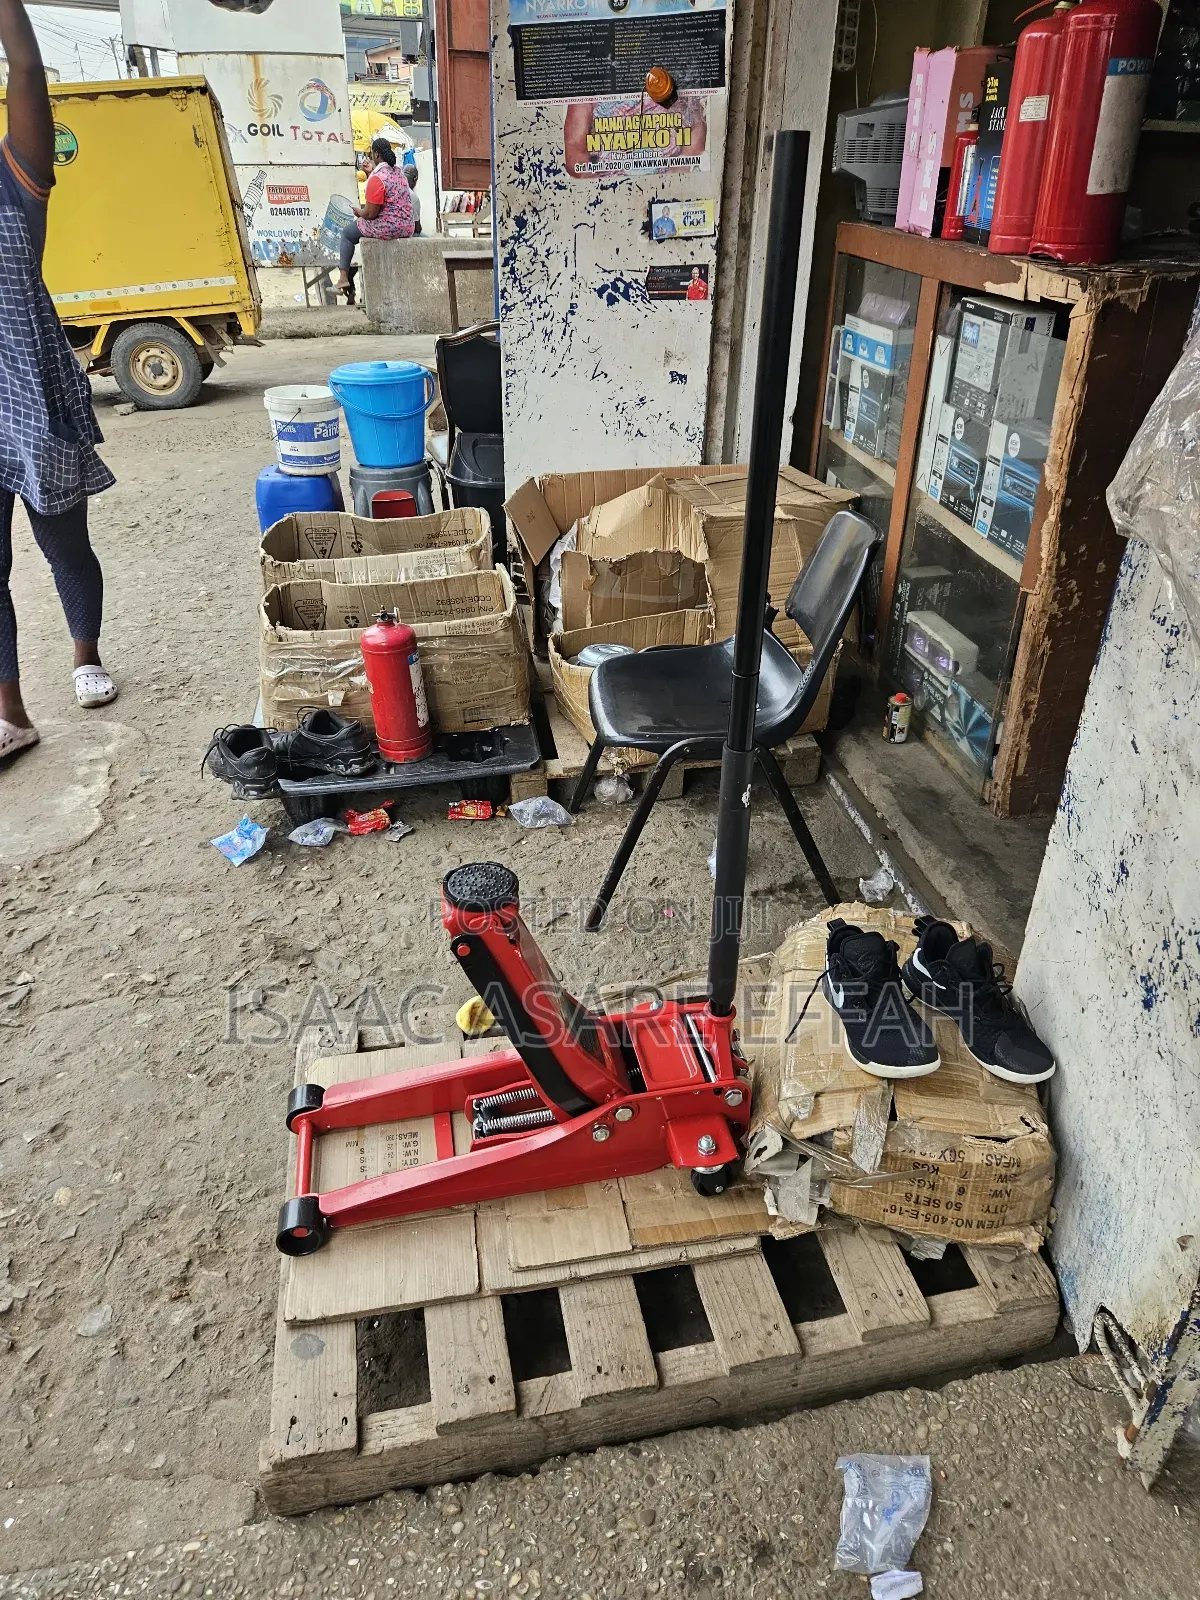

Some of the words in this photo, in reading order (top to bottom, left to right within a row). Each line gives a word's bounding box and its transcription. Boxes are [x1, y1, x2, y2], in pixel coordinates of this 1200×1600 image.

[595, 117, 621, 132] NANA
[624, 113, 682, 131] AGYAPONG
[247, 122, 284, 137] GOIL
[290, 125, 345, 143] TOTAL
[587, 128, 671, 152] NYARKO
[611, 150, 663, 160] Kwamanhene
[575, 163, 587, 172] 3rd
[588, 161, 603, 172] April
[604, 161, 622, 171] 2020
[670, 156, 702, 167] KWAMAN
[270, 207, 311, 217] 0244661872
[1046, 315, 1054, 337] SONY
[395, 1131, 419, 1141] MEAS:
[401, 1158, 419, 1167] QTY:
[908, 1177, 936, 1190] KGS
[957, 1186, 966, 1196] 6
[904, 1192, 941, 1209] SETS
[945, 1200, 963, 1212] 50
[951, 1219, 973, 1229] NO:
[975, 1218, 1006, 1231] ITEM
